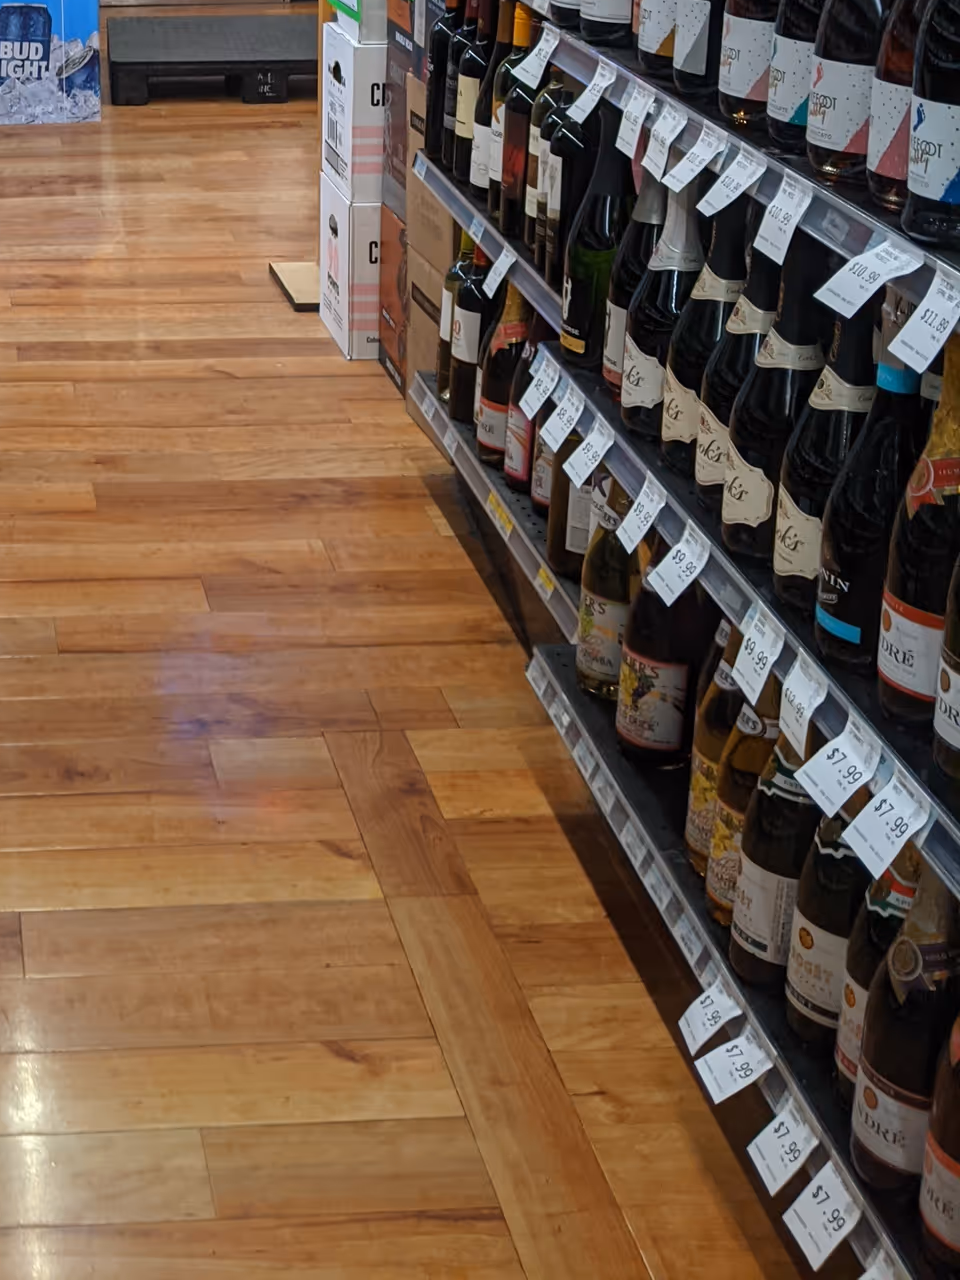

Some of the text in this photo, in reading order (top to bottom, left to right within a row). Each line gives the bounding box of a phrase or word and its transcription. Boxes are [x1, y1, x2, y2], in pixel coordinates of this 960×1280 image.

[0, 42, 44, 62] BUD
[848, 260, 880, 286] $10.99
[671, 549, 698, 576] $9.99
[743, 636, 769, 671] $9.99
[825, 746, 864, 786] $7.99
[873, 798, 910, 840] $7.99
[699, 994, 722, 1028] $7.99
[725, 1043, 754, 1080] $7.99
[772, 1121, 802, 1164] $7.99
[811, 1184, 846, 1233] $7.99
